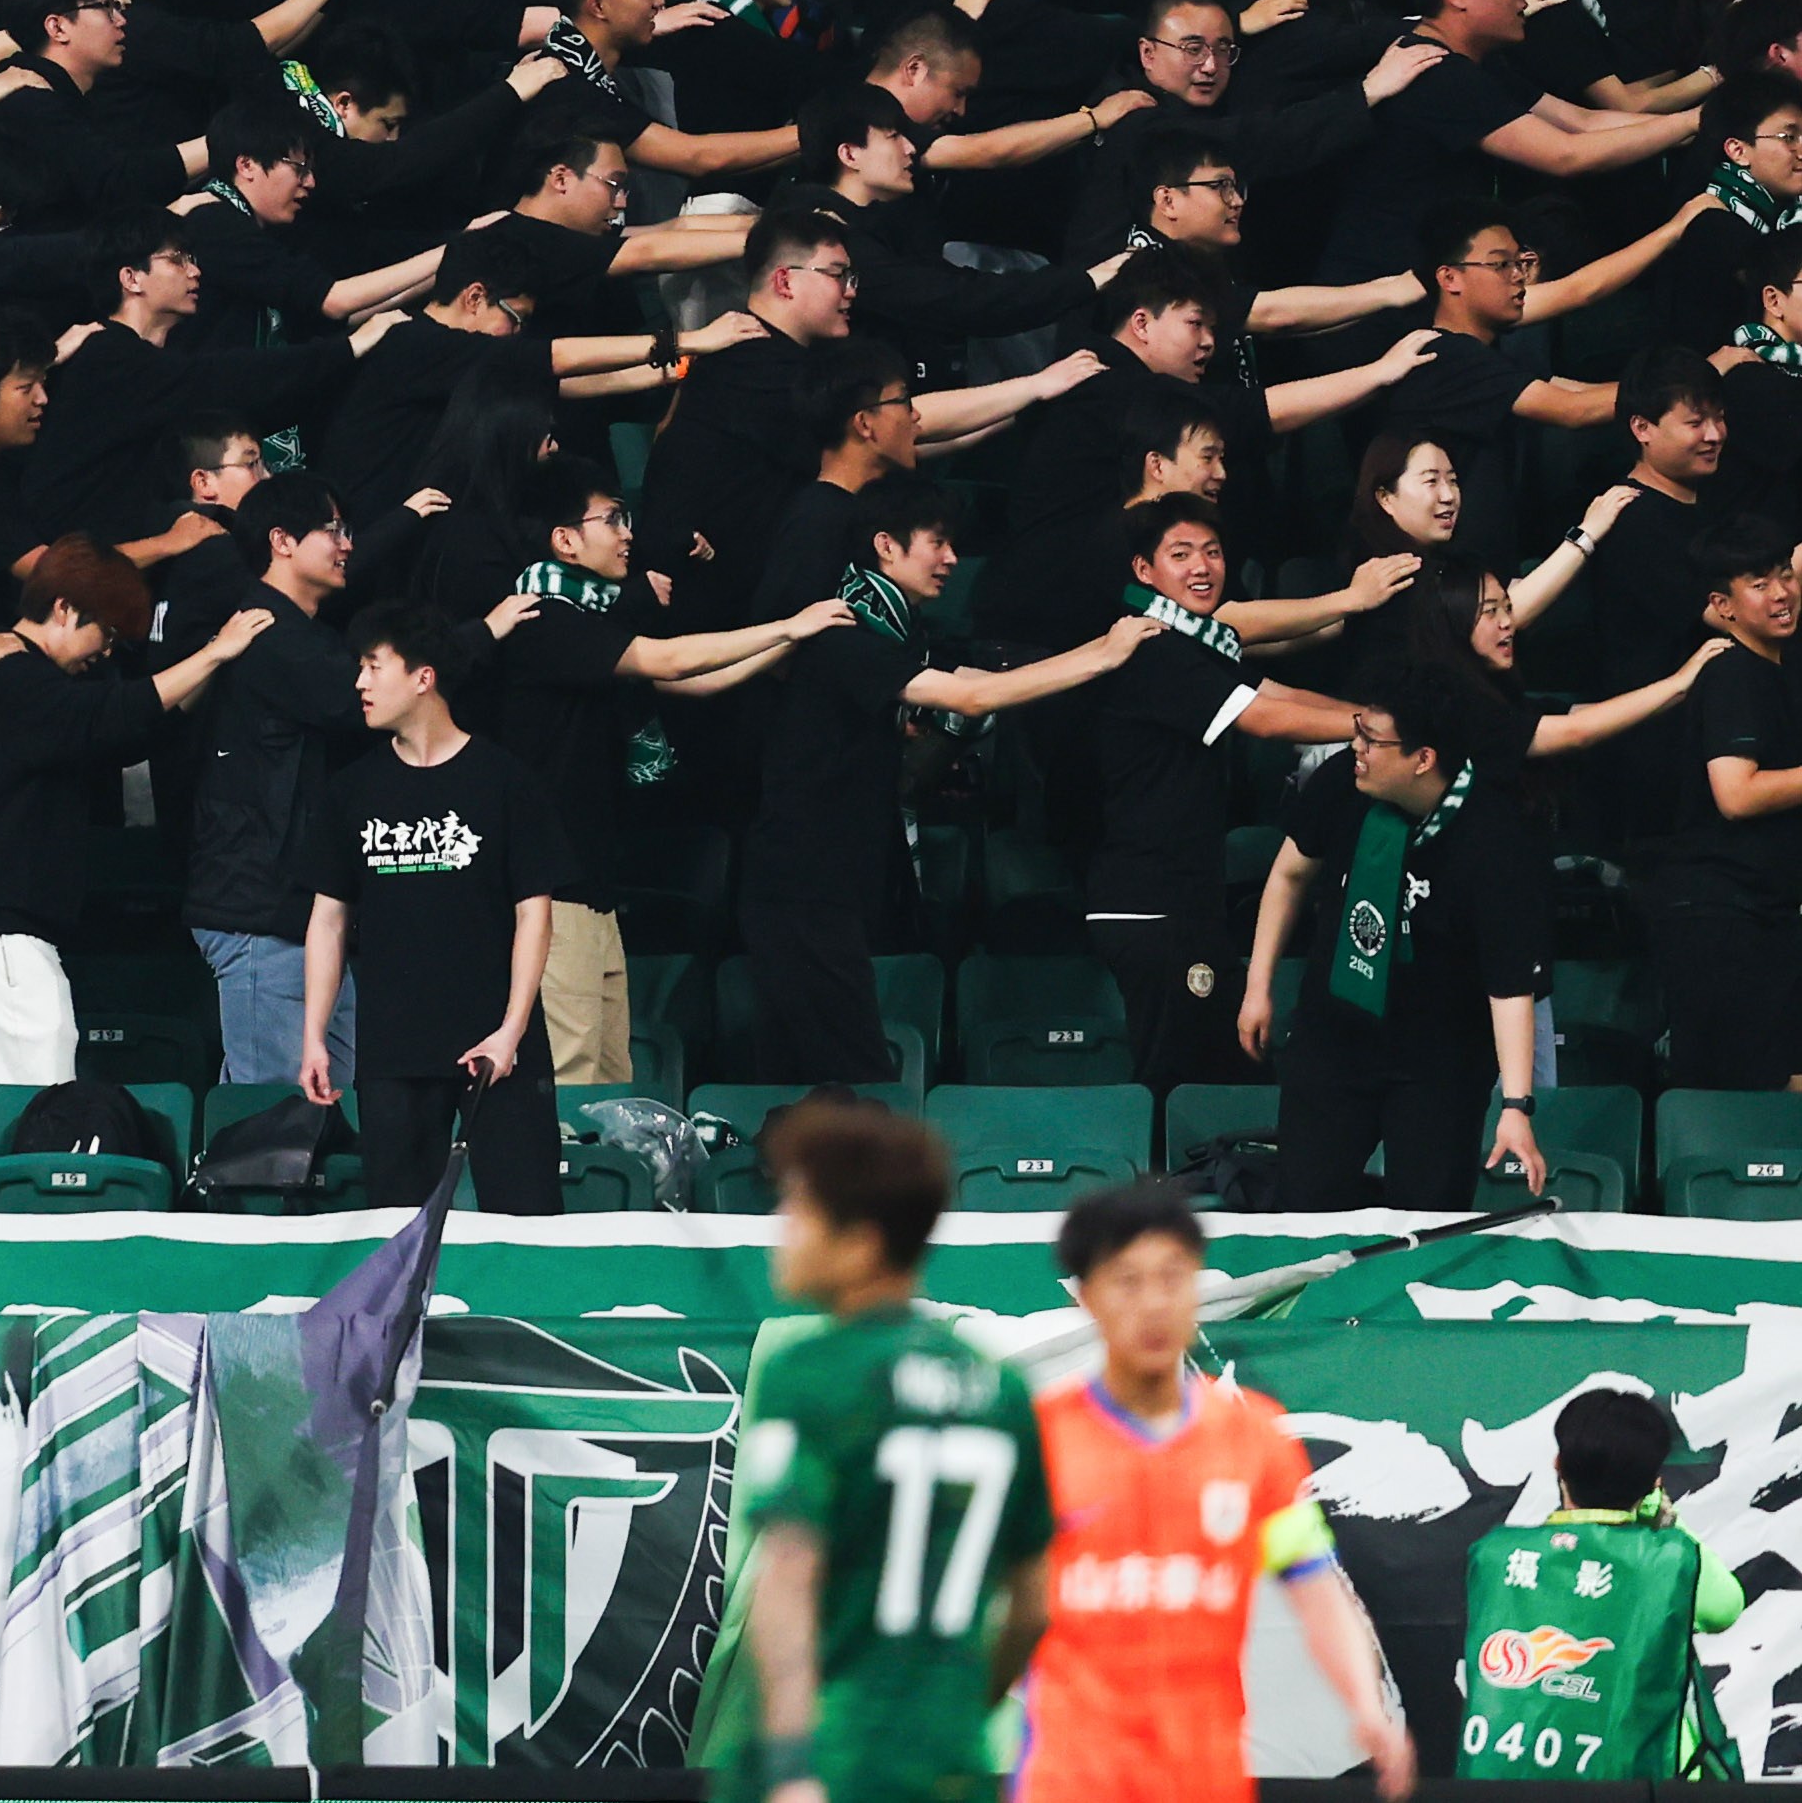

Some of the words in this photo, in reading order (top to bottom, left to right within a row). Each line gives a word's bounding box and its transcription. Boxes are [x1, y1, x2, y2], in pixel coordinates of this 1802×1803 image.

[360, 810, 483, 860] 北京代表
[1056, 1031, 1076, 1041] 23
[1026, 1161, 1045, 1171] 23
[1756, 1165, 1776, 1177] 26
[875, 1424, 1019, 1639] 17
[1539, 1671, 1601, 1705] CSL
[1461, 1713, 1603, 1774] 0407
